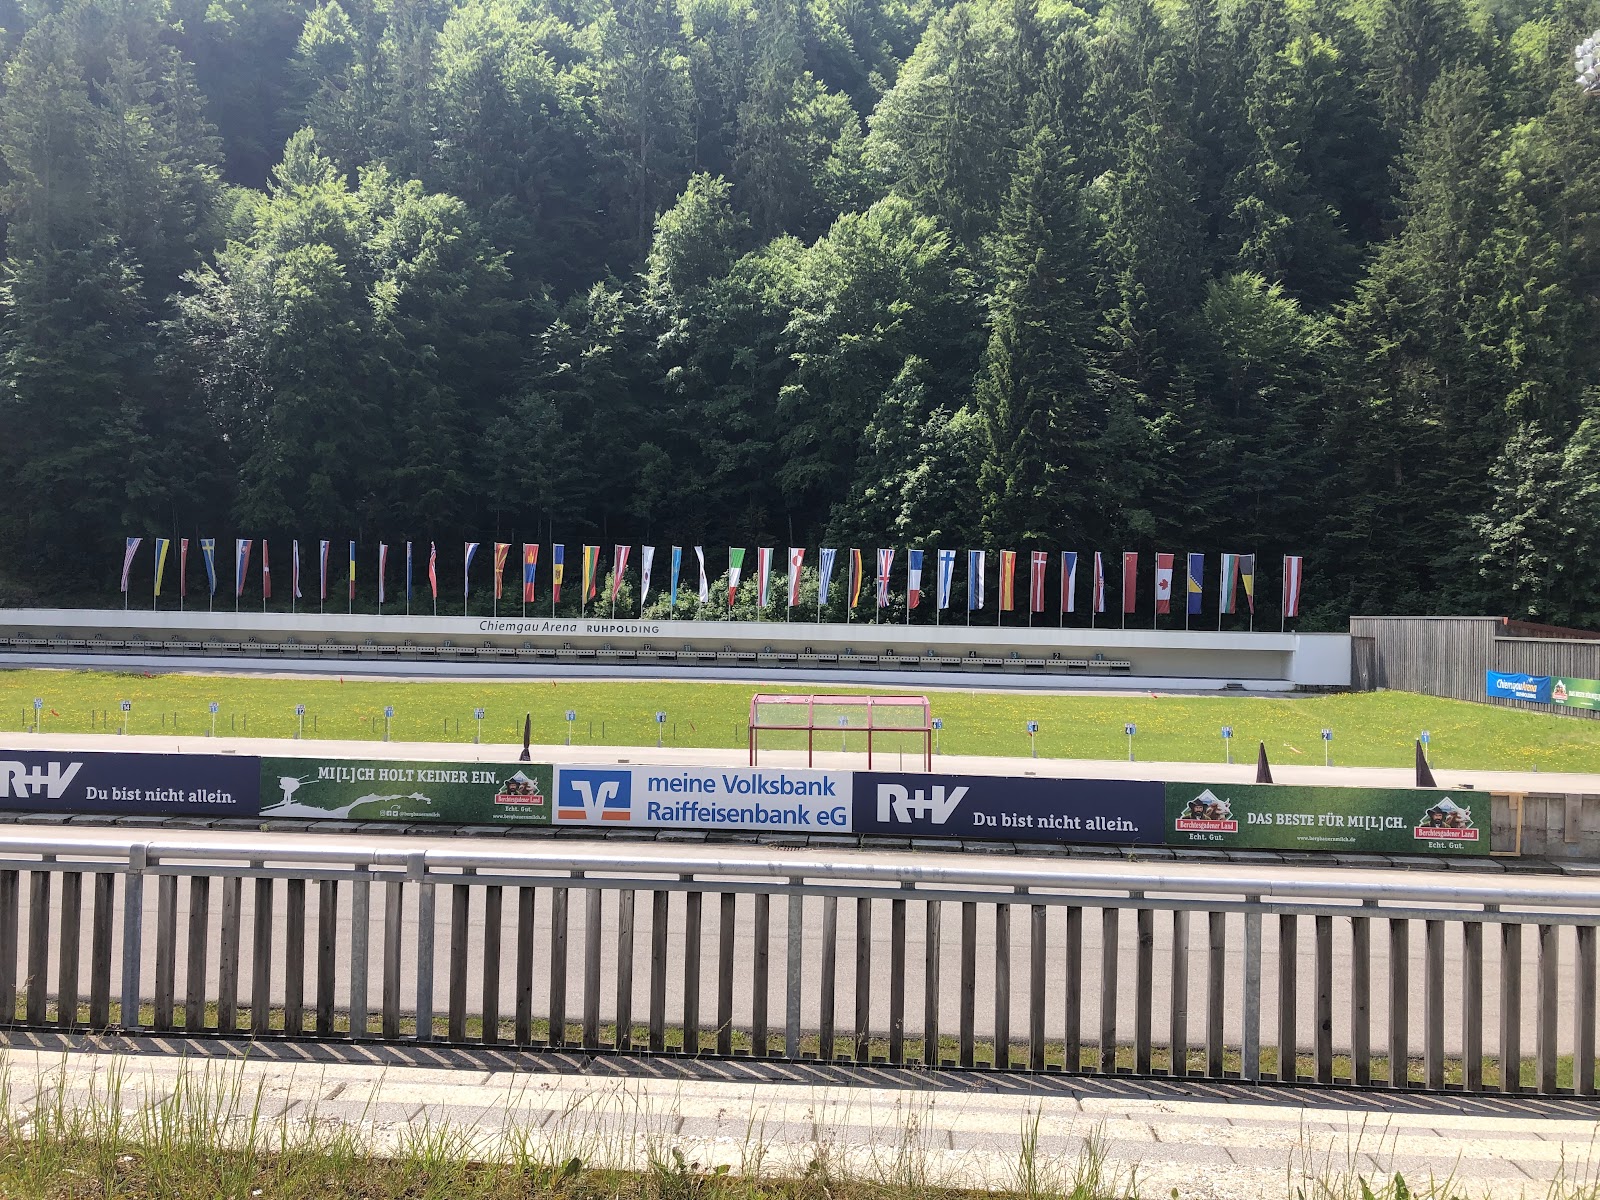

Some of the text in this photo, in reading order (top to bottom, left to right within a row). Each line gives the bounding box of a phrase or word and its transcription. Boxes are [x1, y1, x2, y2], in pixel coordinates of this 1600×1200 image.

[479, 620, 660, 634] Chiemgau Arena RUHPOLDING
[0, 761, 83, 799] R+V
[317, 766, 500, 784] MI[L]CH HOLT KEINER EIN.
[647, 773, 836, 796] meine Volksbank
[85, 786, 237, 805] Du bist nicht allein.
[875, 783, 970, 825] R+V
[647, 801, 847, 826] Raiffeisenbank eG
[972, 811, 1140, 832] Du bist nicht allein.
[1247, 812, 1408, 831] DAS BESTE FÜR MI[L]CH.
[1179, 821, 1234, 830] Berchtesgadener Land
[1418, 828, 1475, 838] Berchtesgadener Land
[1189, 833, 1207, 841] Echt.
[1428, 841, 1447, 849] Echt.
